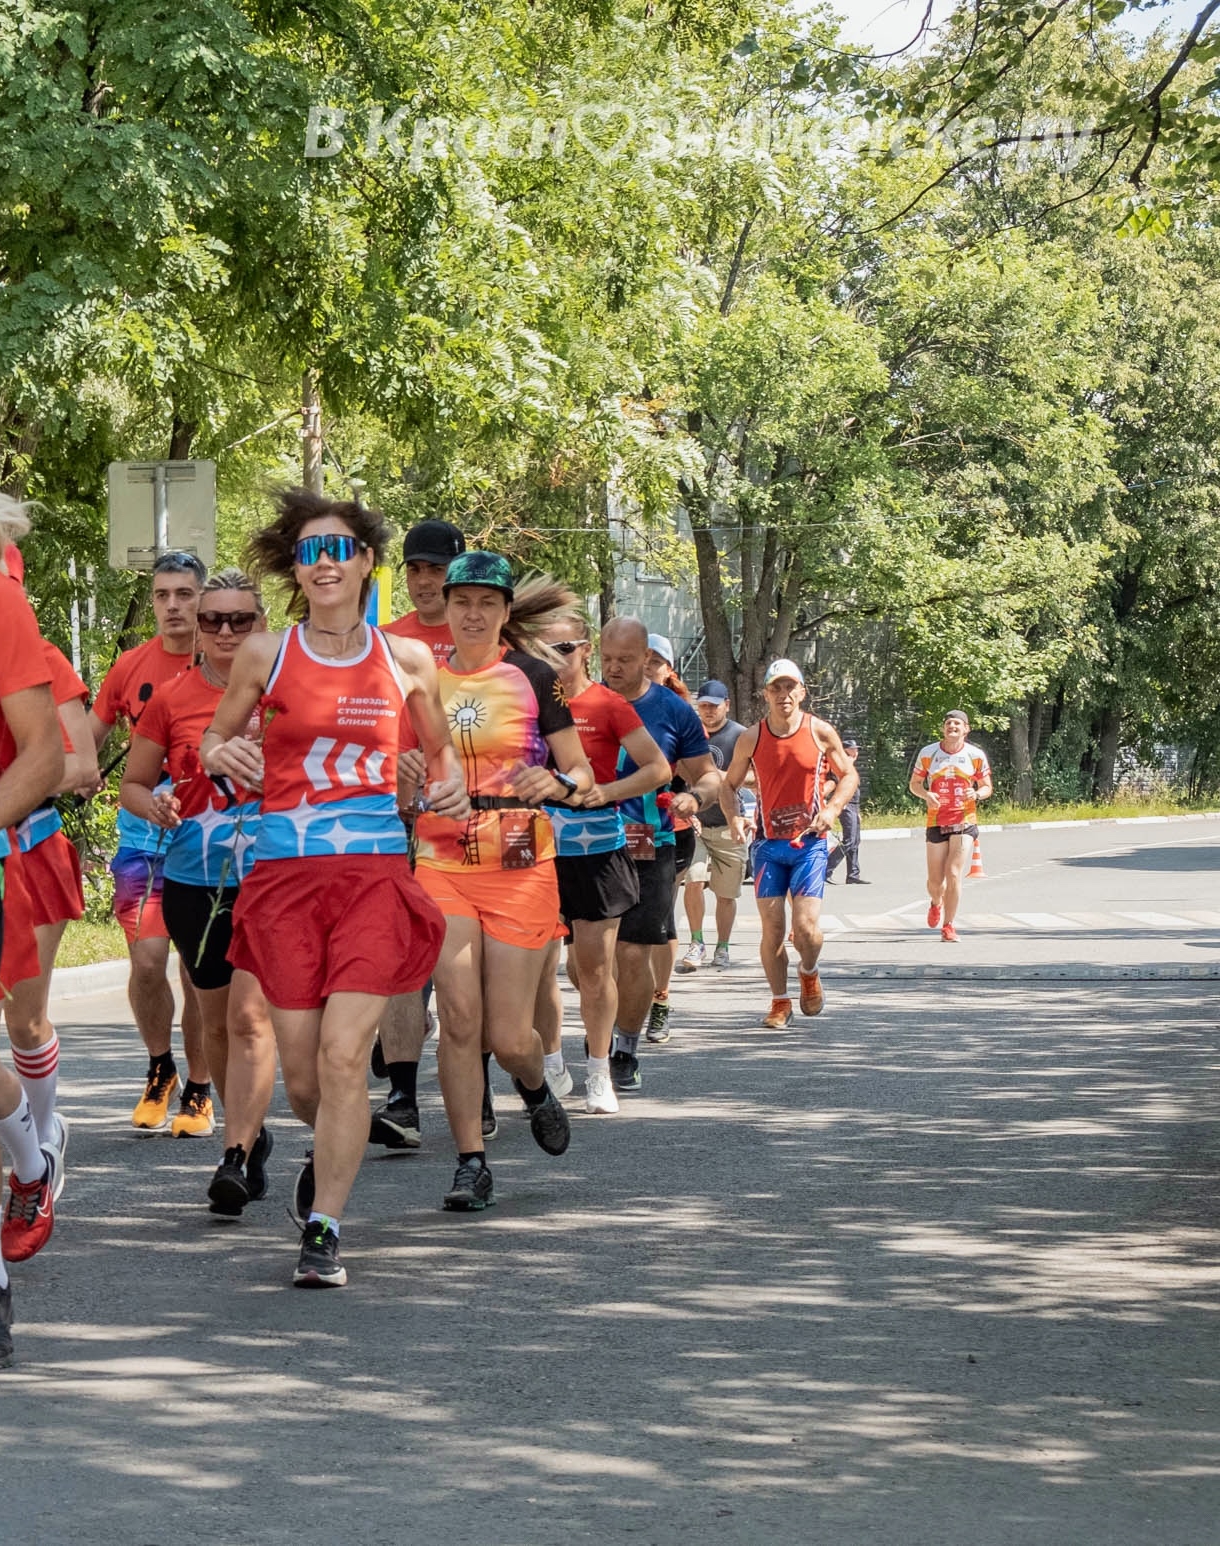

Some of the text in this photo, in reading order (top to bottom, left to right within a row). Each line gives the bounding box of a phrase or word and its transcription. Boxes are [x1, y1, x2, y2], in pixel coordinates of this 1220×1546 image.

[337, 696, 390, 706] И звезды
[336, 707, 398, 718] становятся
[337, 716, 378, 727] ближе
